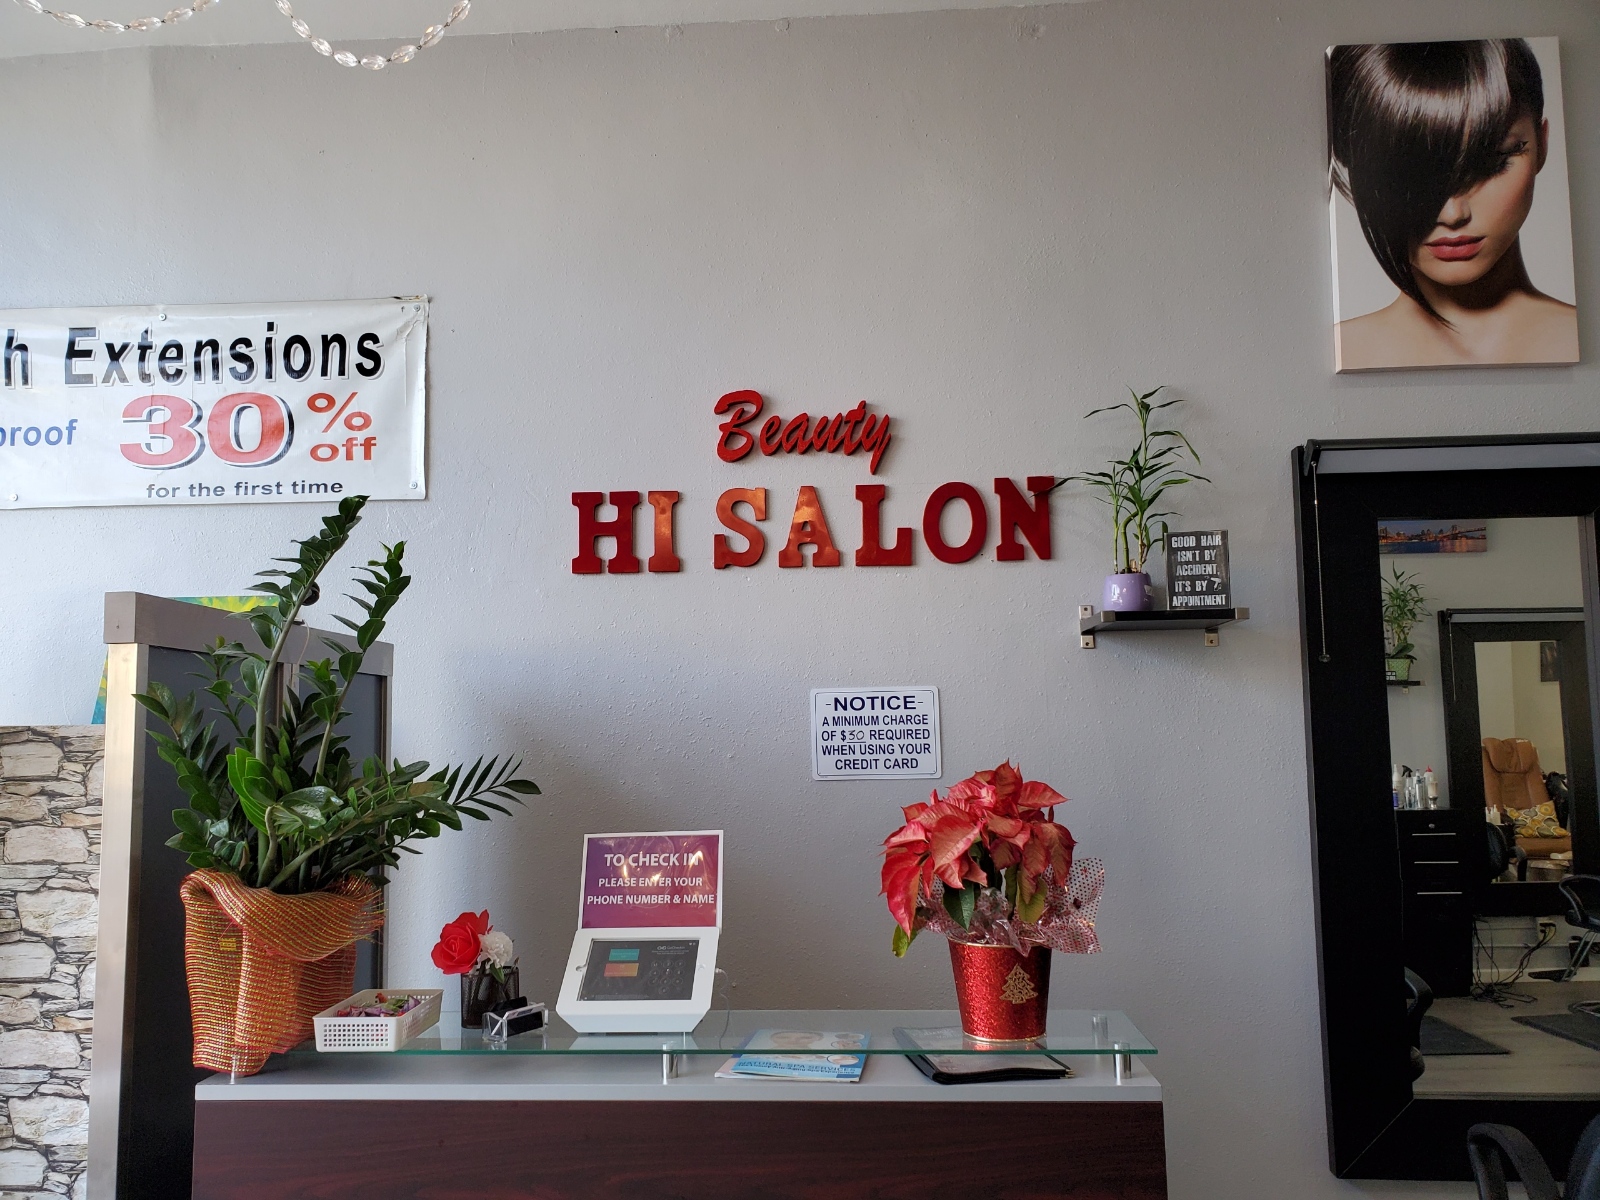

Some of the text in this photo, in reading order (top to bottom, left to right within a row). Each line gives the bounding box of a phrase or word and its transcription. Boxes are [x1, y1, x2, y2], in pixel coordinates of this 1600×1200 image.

[4, 321, 386, 389] h Extensions
[713, 389, 892, 475] Beauty
[309, 436, 378, 463] off
[146, 479, 344, 499] for the first time
[571, 475, 1056, 575] HI SALON
[1171, 534, 1222, 548] GOOD HAIR
[1177, 549, 1217, 562] ISN'T BY
[1174, 580, 1208, 593] IT'S BY
[1172, 594, 1227, 607] APPOINTMENT
[822, 714, 929, 727] A MINIMUM CHARGE
[821, 730, 837, 741] OF
[869, 728, 931, 740] REQUIRED
[821, 743, 932, 756] WHEN USING YOUR
[835, 757, 919, 770] CREDIT CARD
[604, 853, 625, 867] TO
[628, 852, 680, 867] CHECK
[598, 877, 703, 888] PLEASE ENTER YOUR
[587, 894, 715, 905] PHONE NUMBER & NAME
